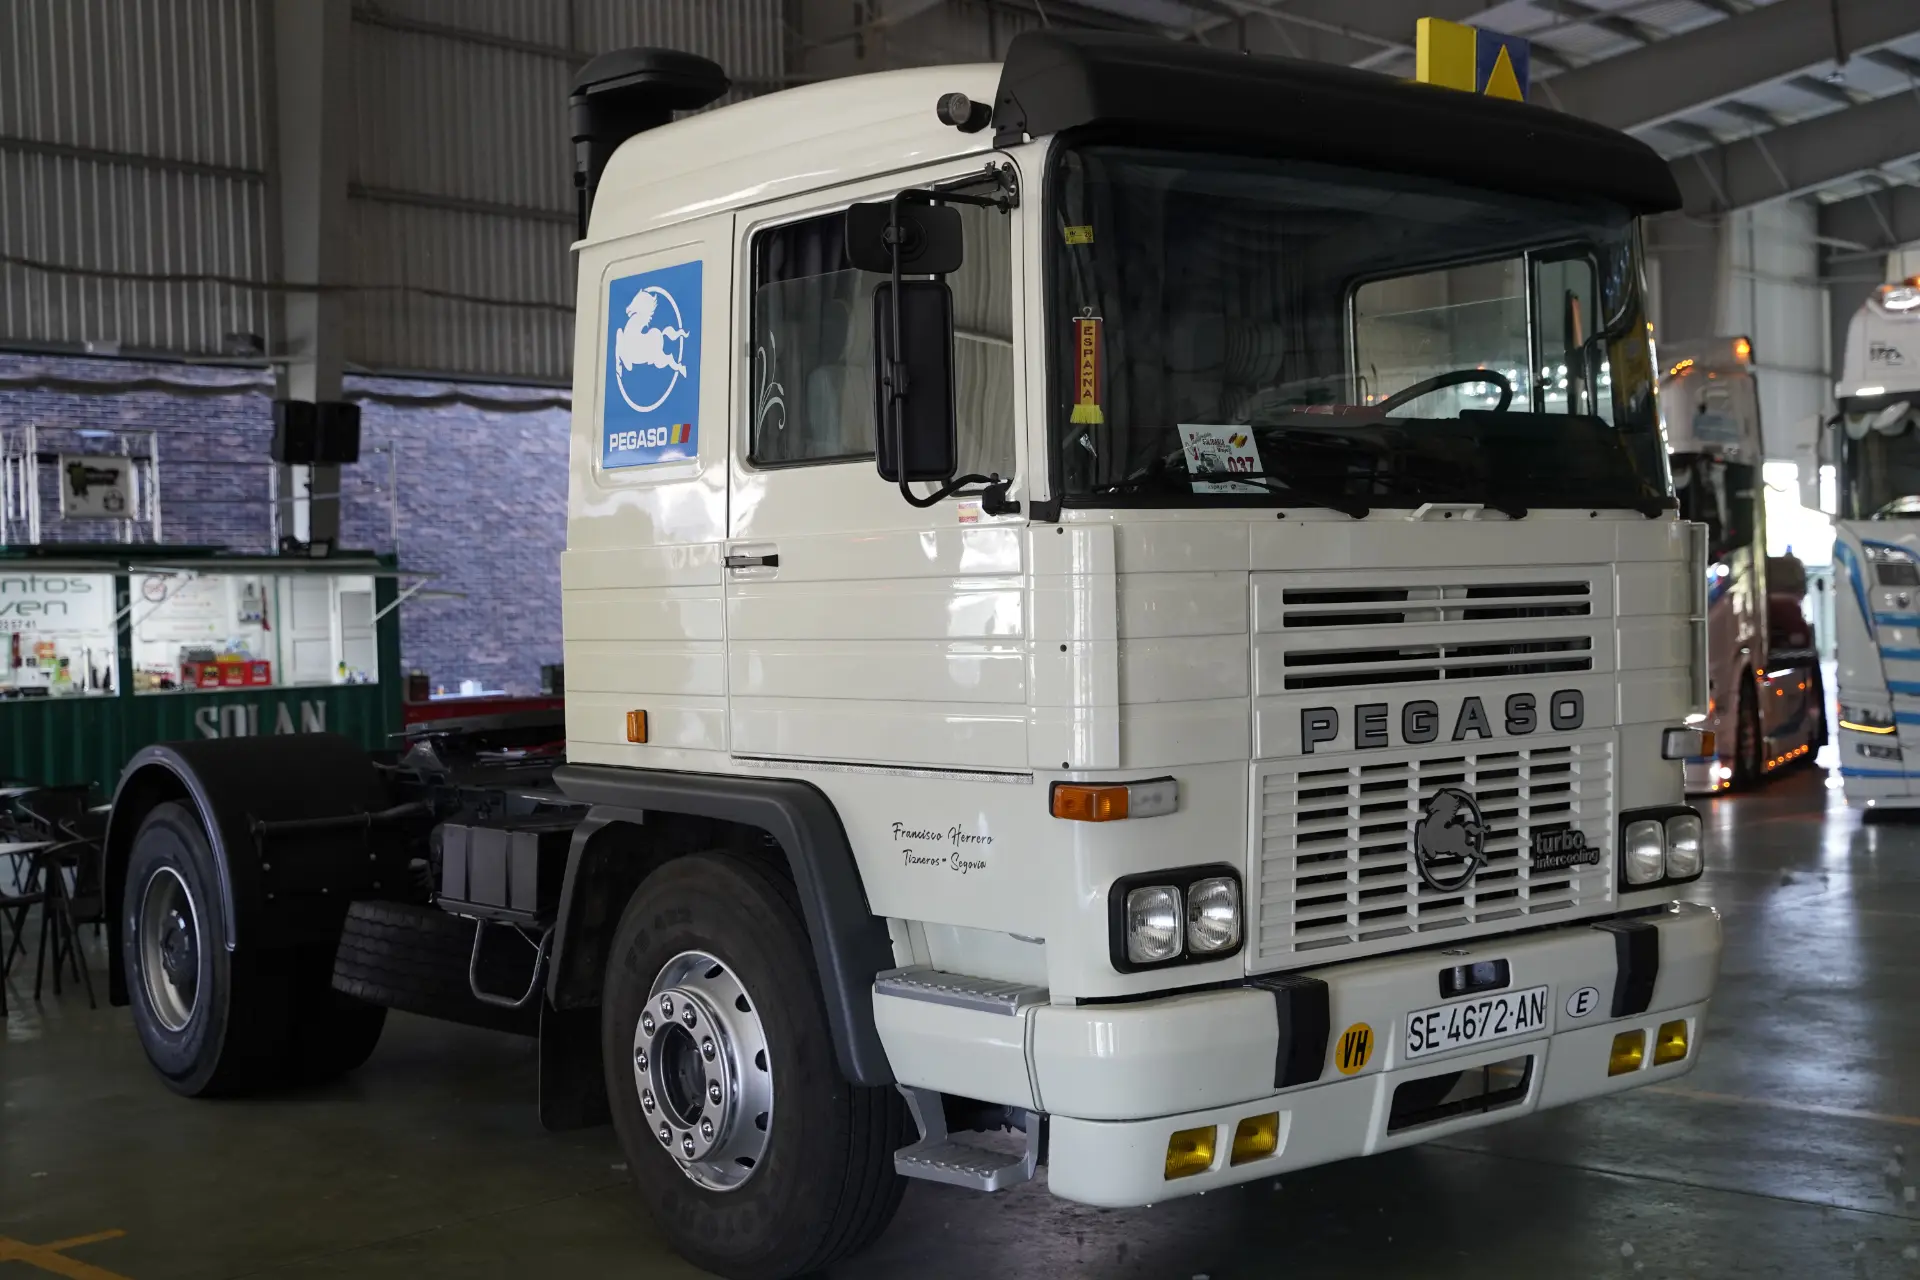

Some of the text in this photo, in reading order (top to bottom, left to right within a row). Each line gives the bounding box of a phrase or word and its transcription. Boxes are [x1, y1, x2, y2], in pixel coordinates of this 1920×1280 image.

[1082, 326, 1094, 398] ESPAÑA
[609, 426, 668, 452] PEGASO
[1300, 688, 1584, 755] PEGASO
[947, 824, 995, 847] Herrero
[1535, 829, 1585, 855] turbo
[950, 851, 987, 874] Segovia
[1536, 848, 1599, 870] intercooling
[1575, 991, 1590, 1014] E
[1344, 1029, 1369, 1069] VH
